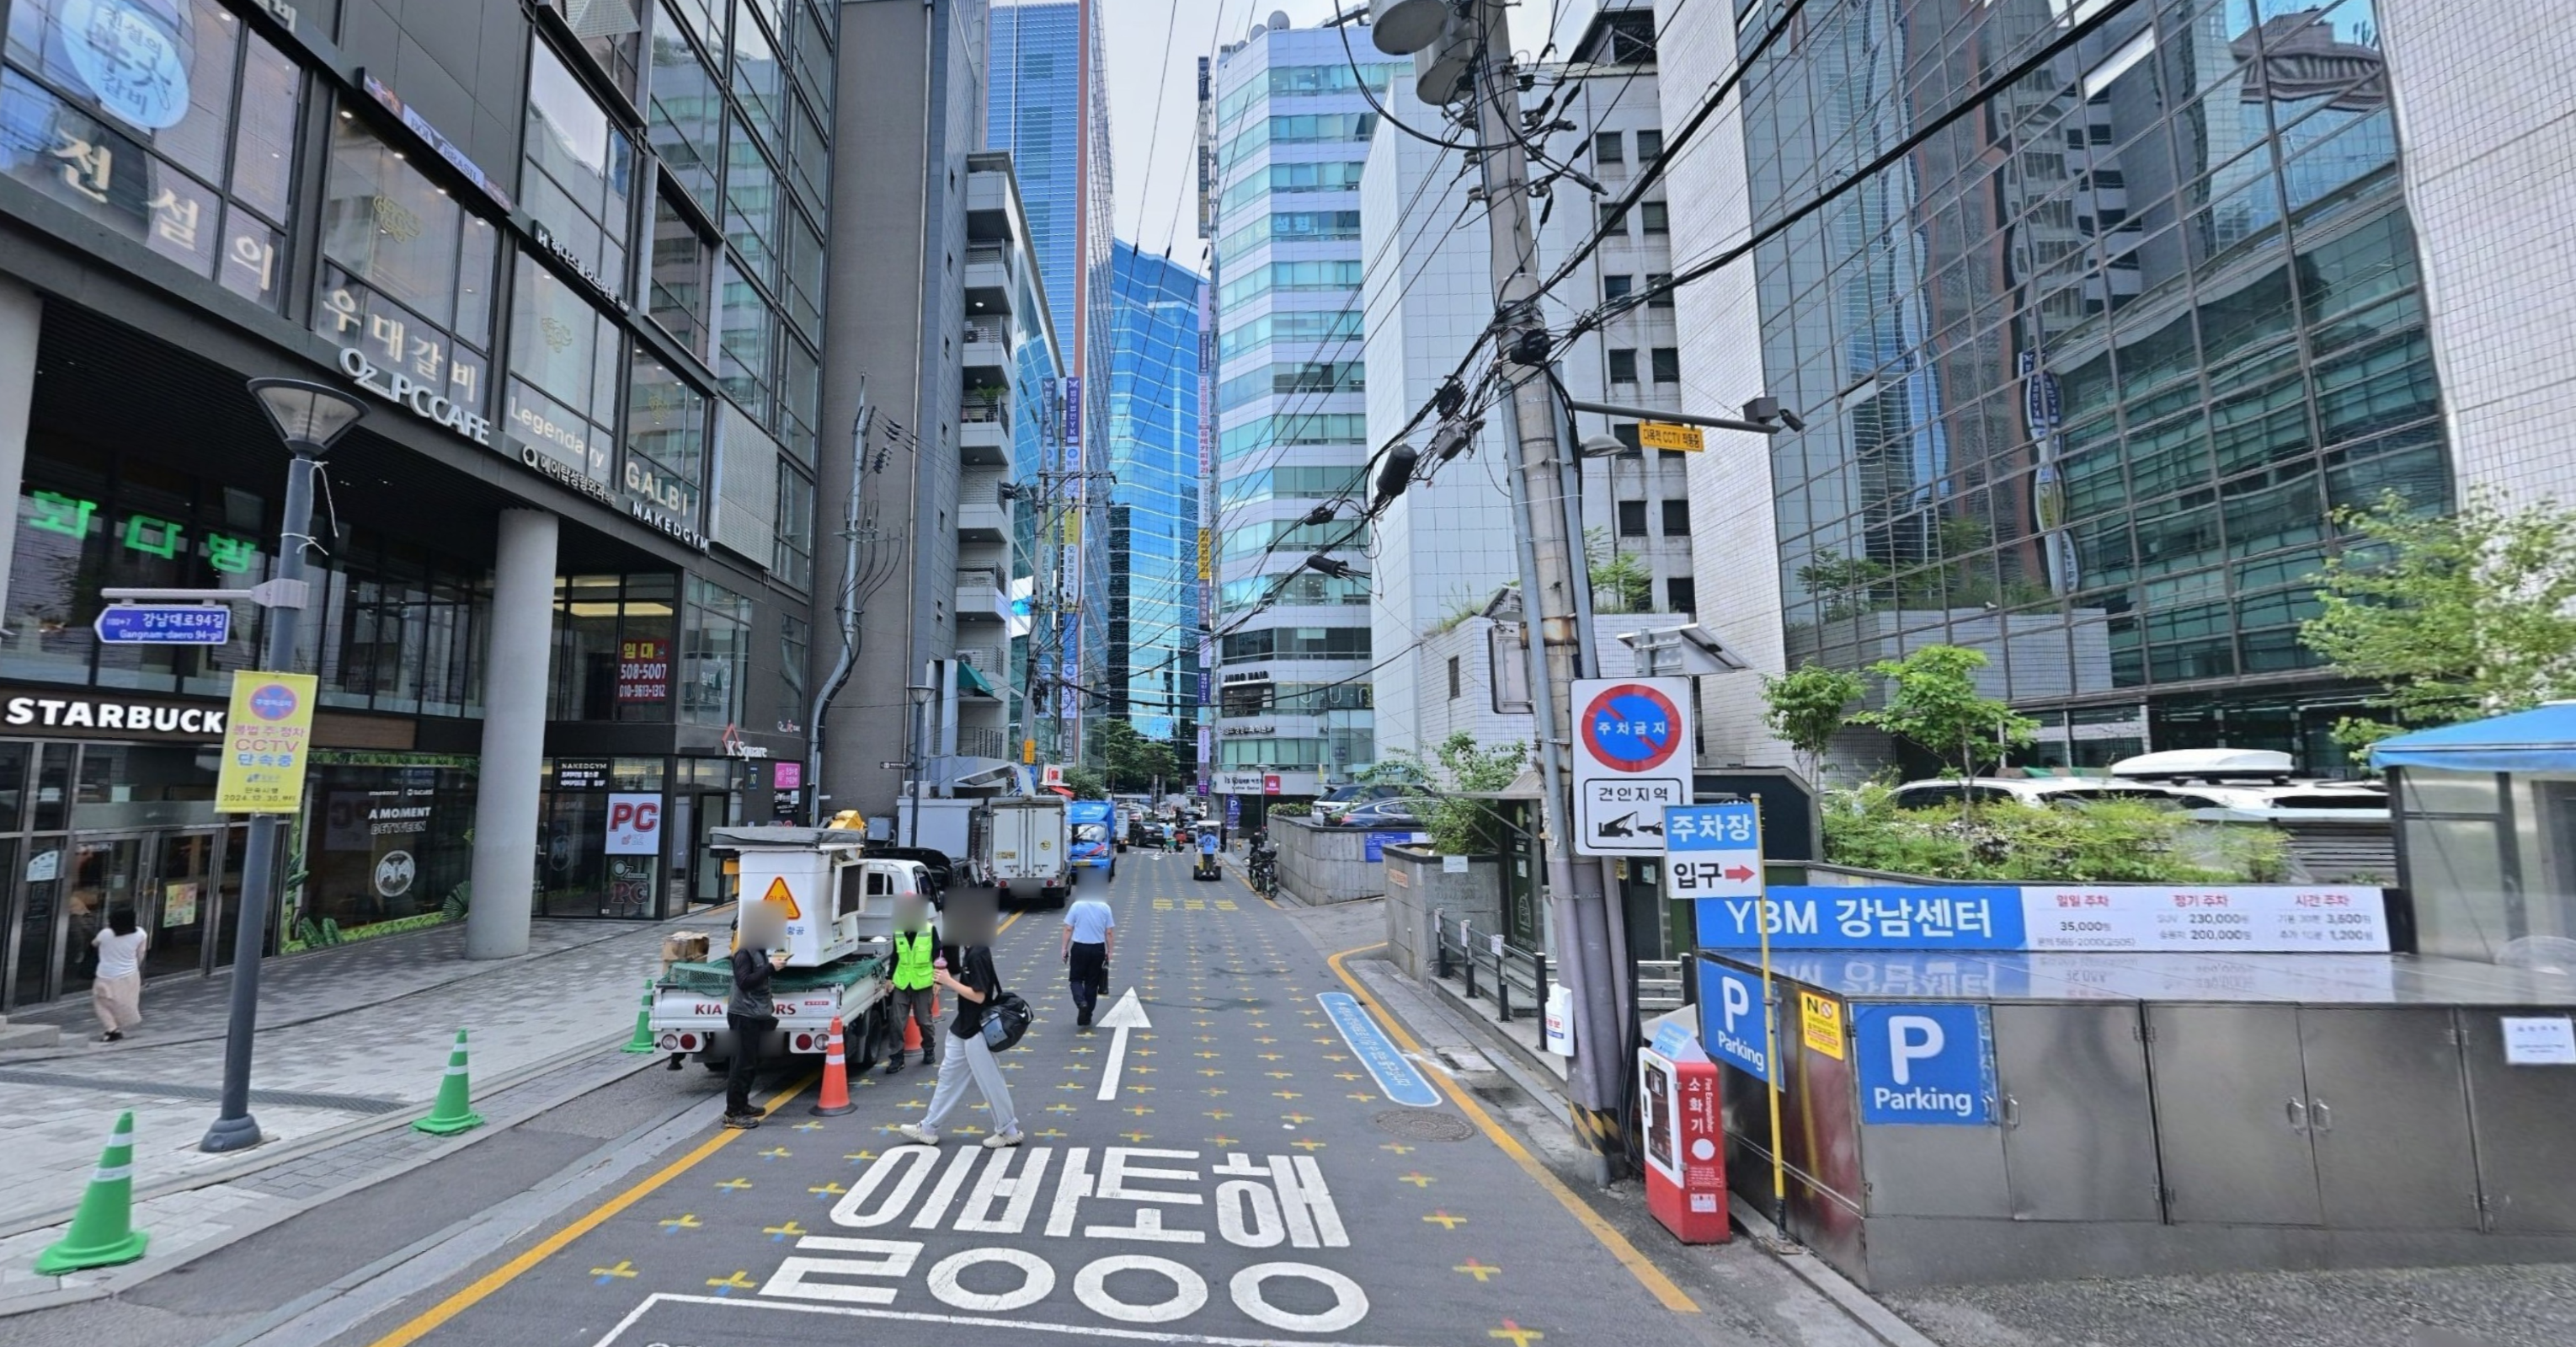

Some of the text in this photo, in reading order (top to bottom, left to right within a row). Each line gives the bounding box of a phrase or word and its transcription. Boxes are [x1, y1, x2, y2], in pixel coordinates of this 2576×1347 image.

[52, 126, 477, 403] 전설의 우대갈비
[510, 397, 688, 516] Legendary GALBI
[632, 500, 709, 552] NAKEDGYM
[142, 612, 225, 628] 강남대로94길
[119, 629, 223, 641] Gangnam-daero 94-gil
[620, 663, 667, 680] 508-5007
[6, 698, 226, 733] STARBUCK
[1597, 721, 1667, 735] 주차금지
[235, 738, 300, 752] CCTV
[727, 740, 767, 762] K Square
[237, 753, 293, 767] 단속중
[1598, 787, 1668, 803] 견인지역
[368, 807, 432, 820] A MOMENT
[608, 802, 659, 832] PC
[1671, 813, 1752, 842] 주차장
[1673, 862, 1723, 890] 입구
[611, 882, 651, 904] PC
[2084, 895, 2109, 907] 주차
[2173, 895, 2229, 908] 정기 주차
[2296, 895, 2350, 907] 시간 주차
[1724, 897, 1993, 938] YBM 강남센터
[695, 1004, 723, 1015] KIA
[1717, 1029, 1765, 1072] Parking
[1888, 1014, 1945, 1086] P
[1688, 1077, 1704, 1134] 소화기
[1874, 1087, 1972, 1117] Parking
